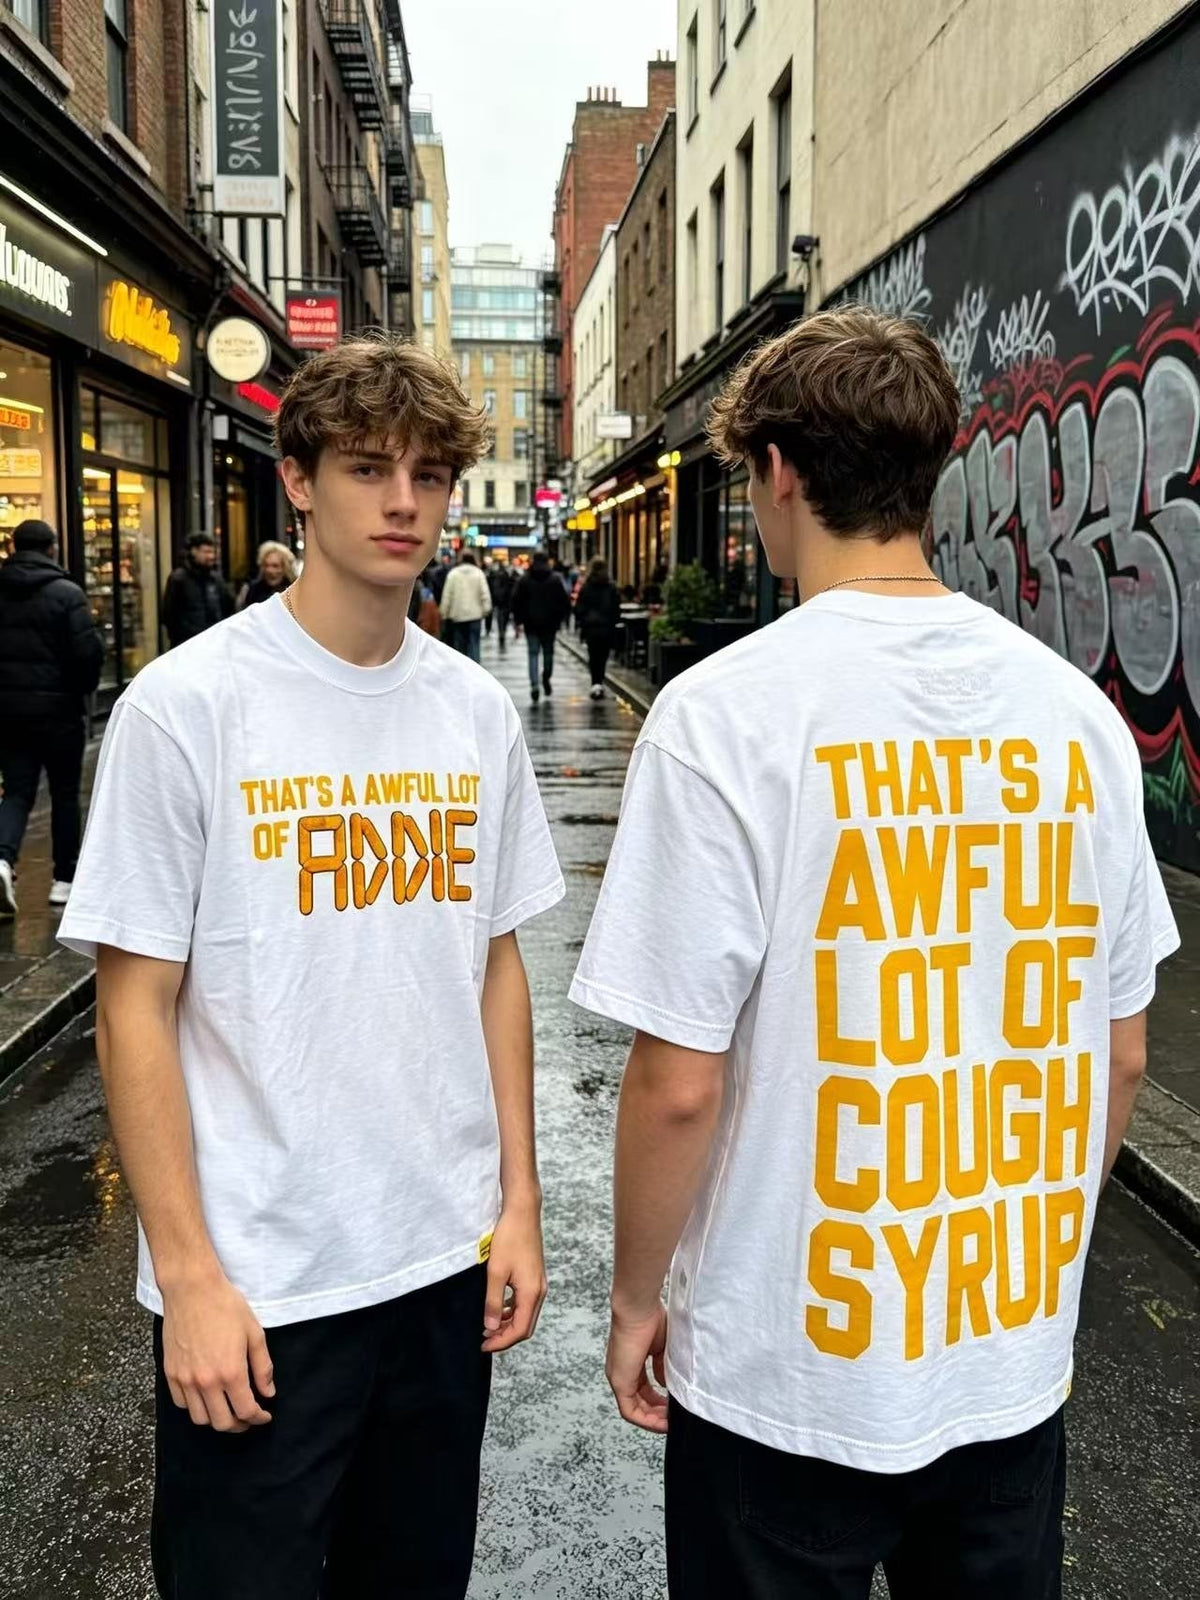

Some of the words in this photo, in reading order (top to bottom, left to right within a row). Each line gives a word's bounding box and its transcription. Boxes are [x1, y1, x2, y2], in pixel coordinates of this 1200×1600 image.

[239, 775, 333, 815] THAT'S
[341, 774, 357, 806] A
[364, 772, 444, 806] AWFUL
[448, 774, 480, 805] LOT
[814, 738, 1040, 820] THAT'S
[1065, 740, 1095, 814] A
[252, 820, 290, 861] OF
[297, 808, 478, 916] ADDIE
[814, 821, 1100, 942] AWFUL
[814, 941, 972, 1068] LOT
[1002, 936, 1097, 1049] OF
[814, 1052, 1092, 1214] COUGH
[805, 1186, 1086, 1361] SYRUP
